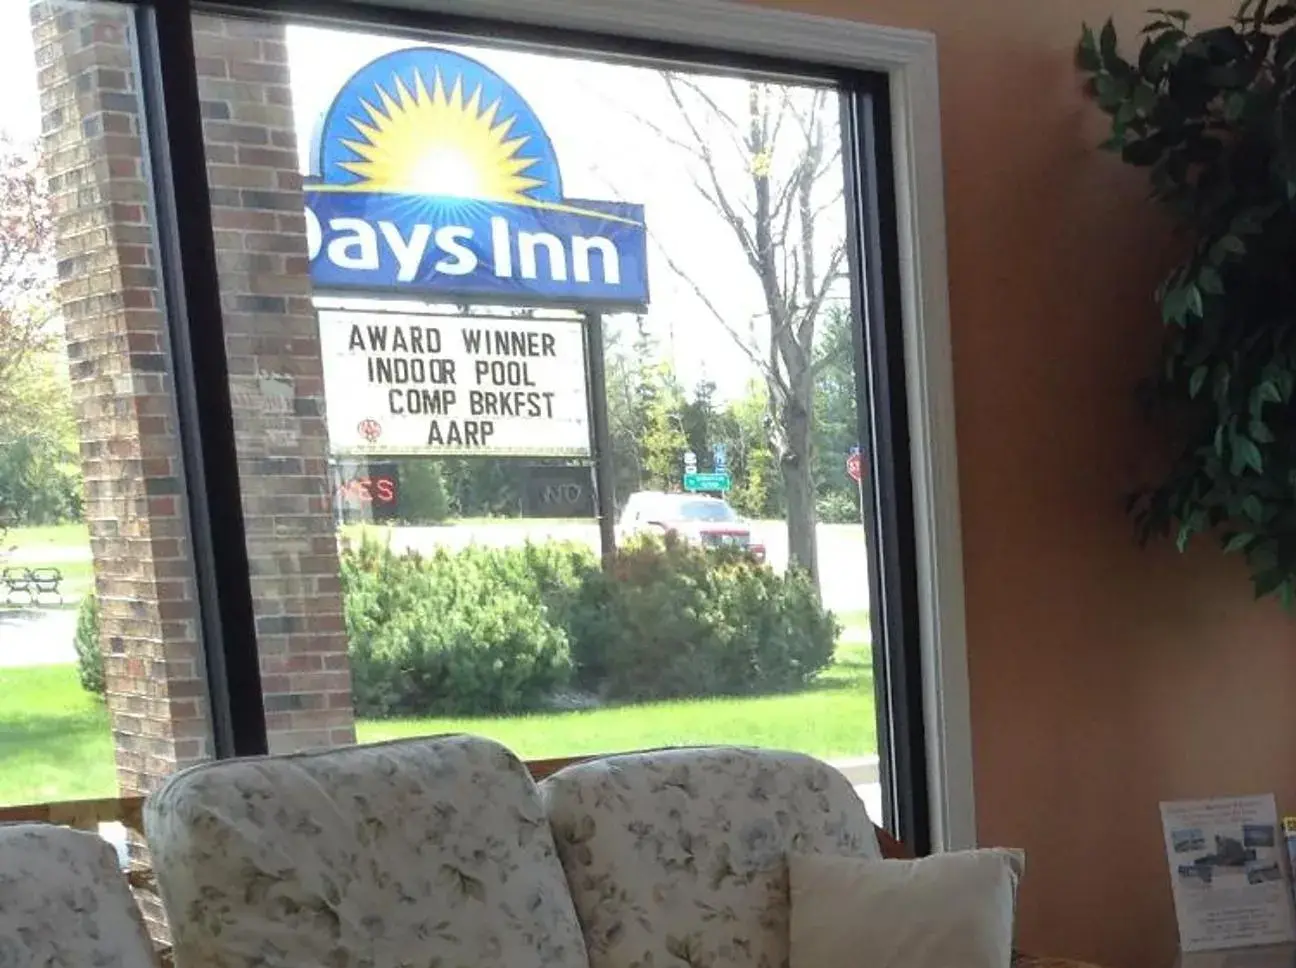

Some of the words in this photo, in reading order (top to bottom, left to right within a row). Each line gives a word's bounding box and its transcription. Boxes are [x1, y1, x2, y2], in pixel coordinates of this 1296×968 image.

[490, 216, 621, 286] Inn
[348, 324, 441, 354] AWARD
[462, 329, 556, 357] WINNER
[368, 357, 456, 385] INDOOR
[476, 361, 536, 387] POOL
[389, 390, 457, 416] COMP
[469, 392, 555, 418] BRKFST
[428, 420, 494, 446] AARP
[542, 483, 582, 505] NO
